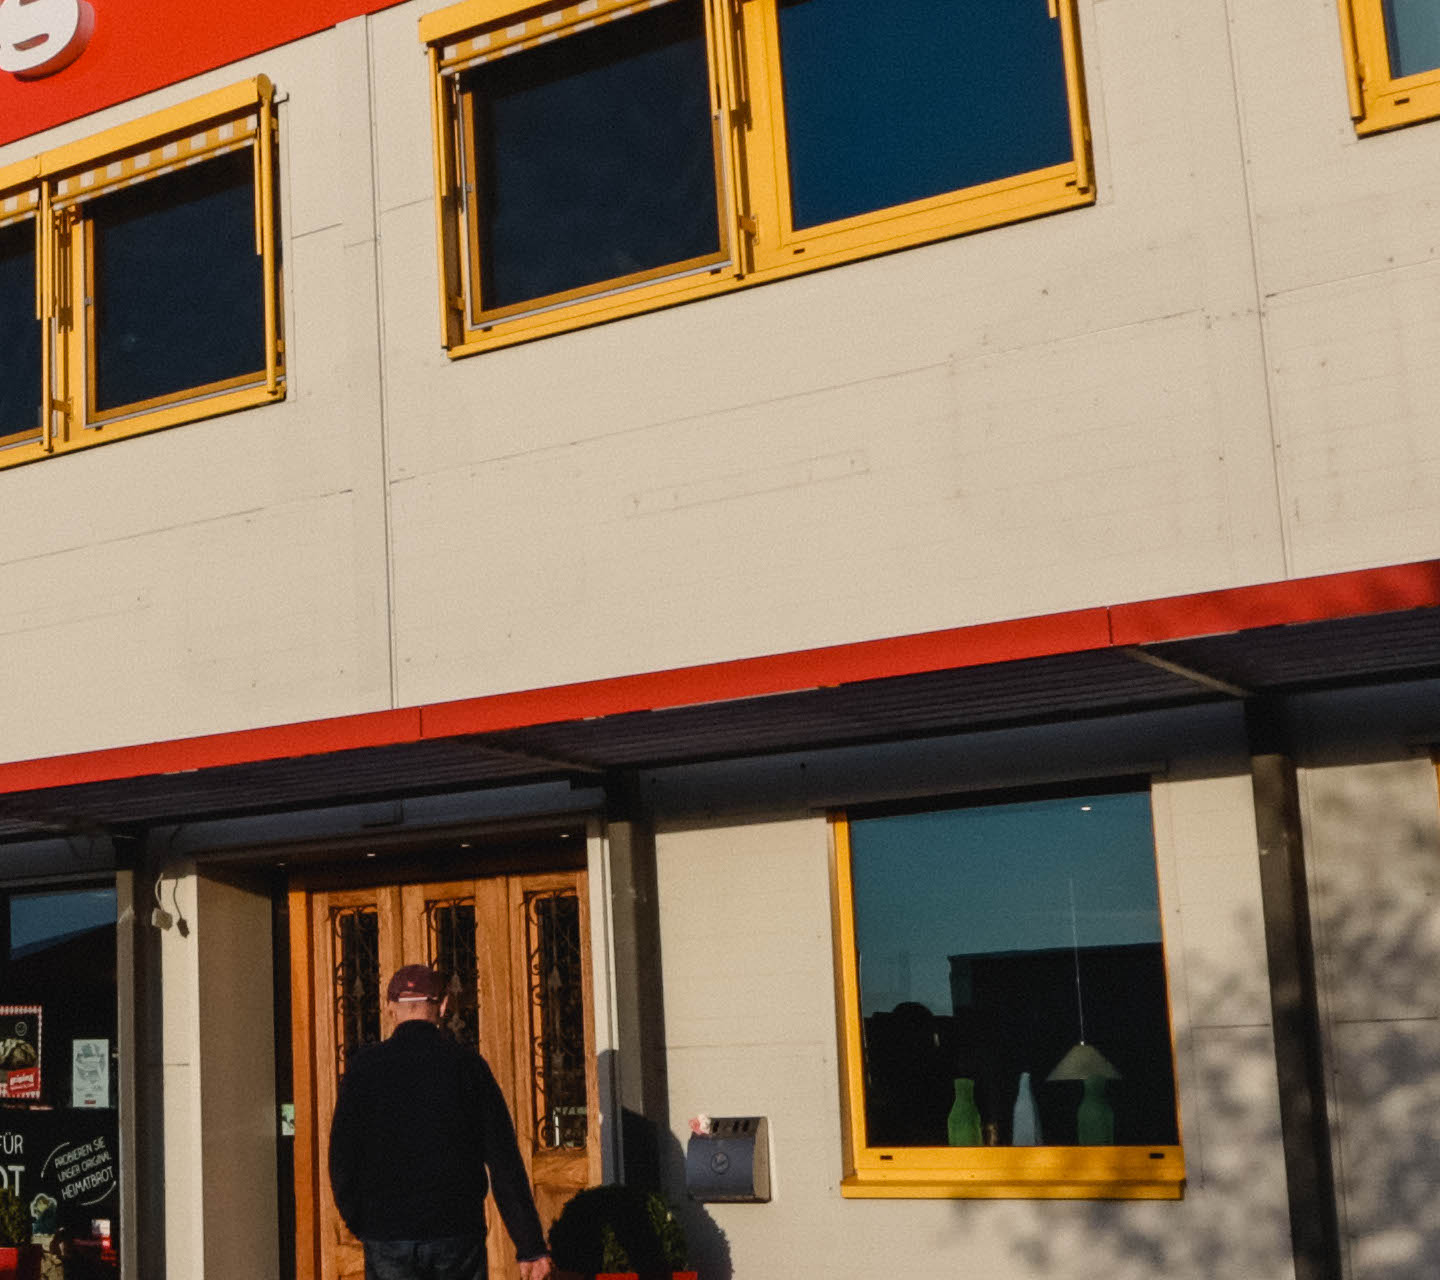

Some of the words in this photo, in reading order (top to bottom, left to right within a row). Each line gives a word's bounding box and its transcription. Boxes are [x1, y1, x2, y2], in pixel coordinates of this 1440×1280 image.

[54, 1143, 93, 1169] PROBIEREN
[92, 1136, 106, 1151] SIE
[57, 1164, 81, 1182] UNSER
[61, 1165, 113, 1200] HEIMATBROT
